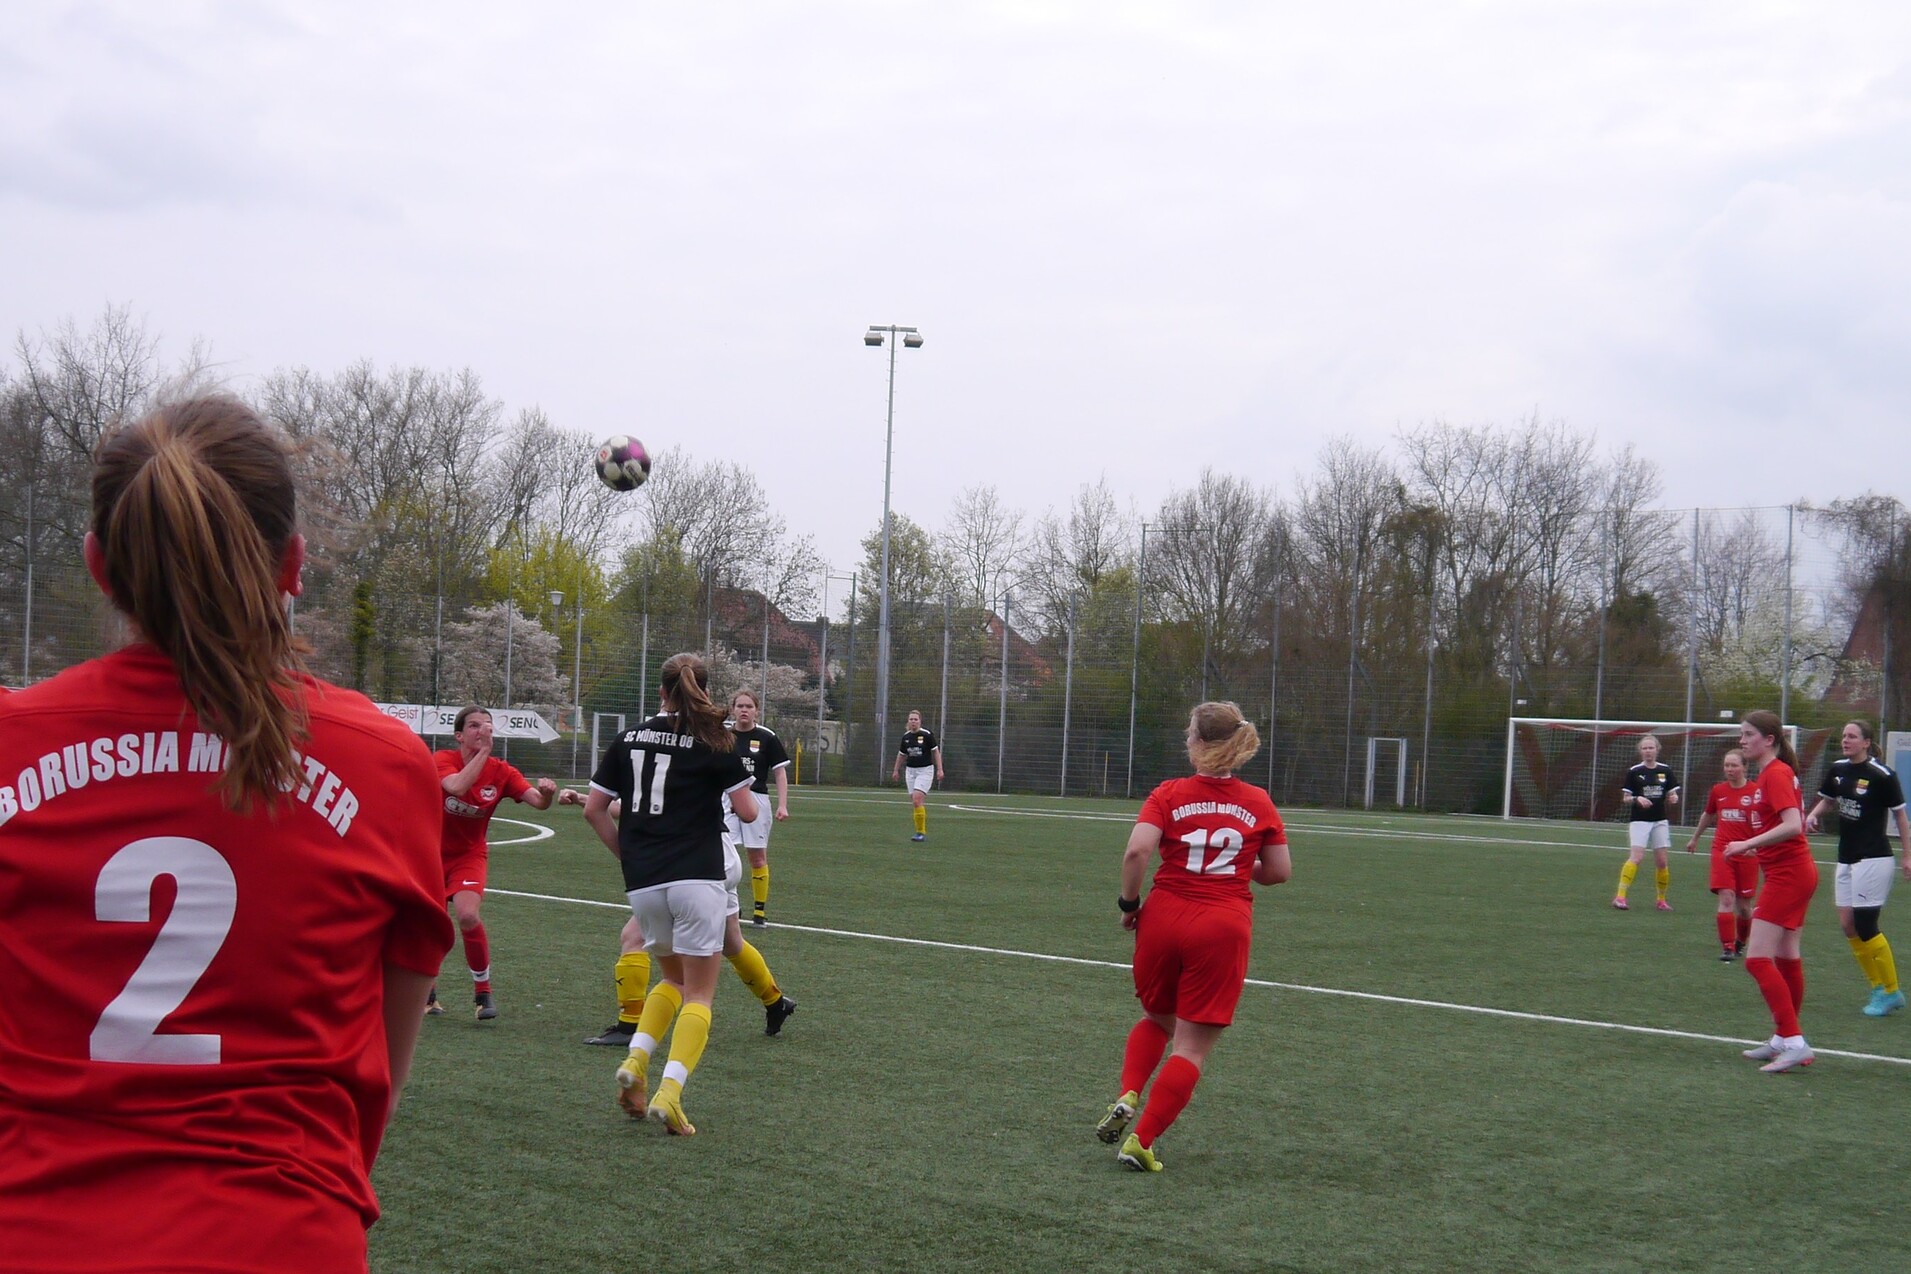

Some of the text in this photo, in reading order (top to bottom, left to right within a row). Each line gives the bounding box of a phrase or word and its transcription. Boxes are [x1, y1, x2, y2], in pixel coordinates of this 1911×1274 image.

[624, 728, 693, 749] SC MÜNSTER 08
[0, 731, 179, 826] BORUSSIA
[630, 749, 672, 815] 11
[1172, 801, 1257, 828] BORUSSIA MÜNSTER
[1181, 827, 1243, 875] 12
[90, 836, 237, 1065] 2
